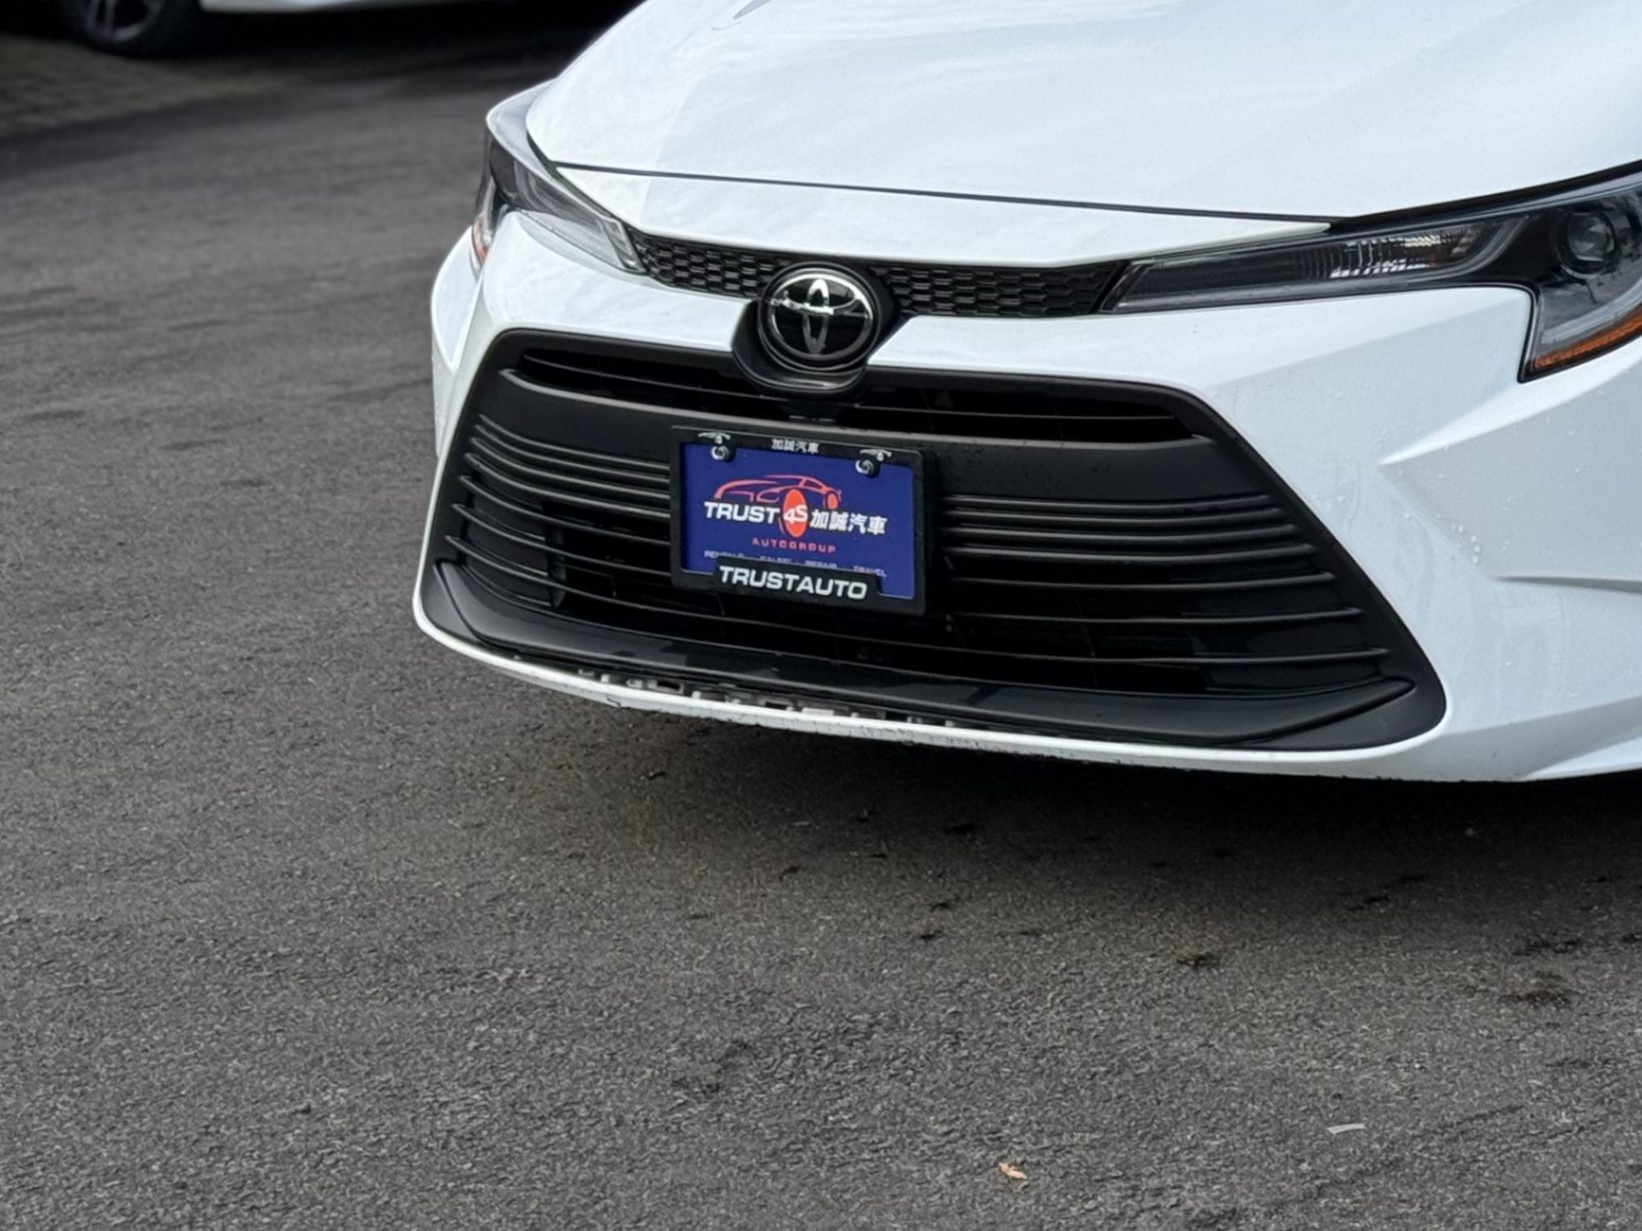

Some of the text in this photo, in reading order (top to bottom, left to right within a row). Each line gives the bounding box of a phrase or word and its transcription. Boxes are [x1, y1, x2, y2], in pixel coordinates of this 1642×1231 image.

[703, 501, 888, 535] TRUST 4S 加誠汽車
[752, 537, 837, 554] AUTOGROUP
[719, 565, 868, 600] TRUSTAUTO
